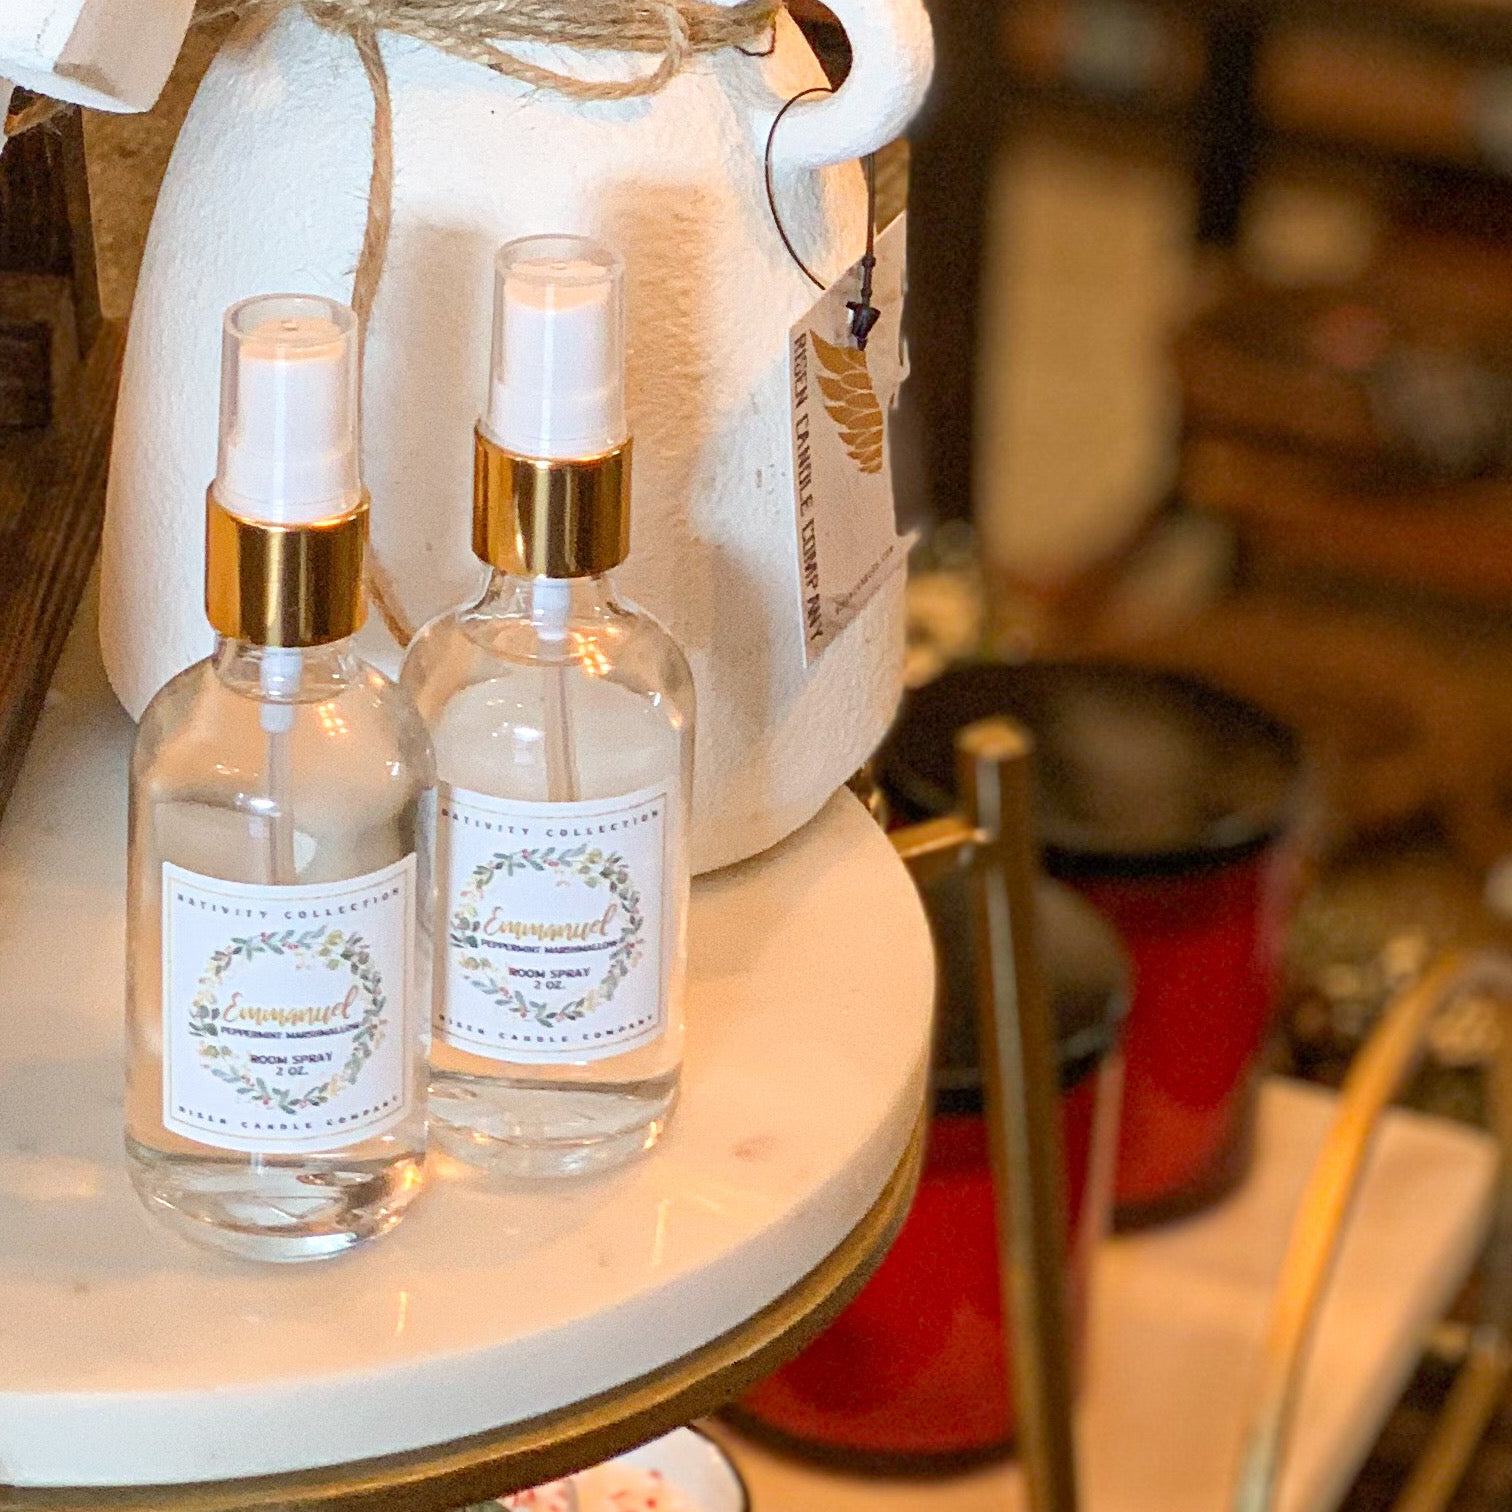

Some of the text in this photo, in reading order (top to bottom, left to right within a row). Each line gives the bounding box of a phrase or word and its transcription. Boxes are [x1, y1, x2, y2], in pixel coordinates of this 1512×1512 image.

[794, 413, 814, 517] CANDLE
[440, 807, 659, 837] NATIVITY COLLECTION
[176, 887, 400, 919] NATIVITY COLLECTION
[508, 966, 591, 978] ROOM SPRAY
[250, 1050, 333, 1064] ROOM SPRAY
[241, 1121, 312, 1130] CANDLE
